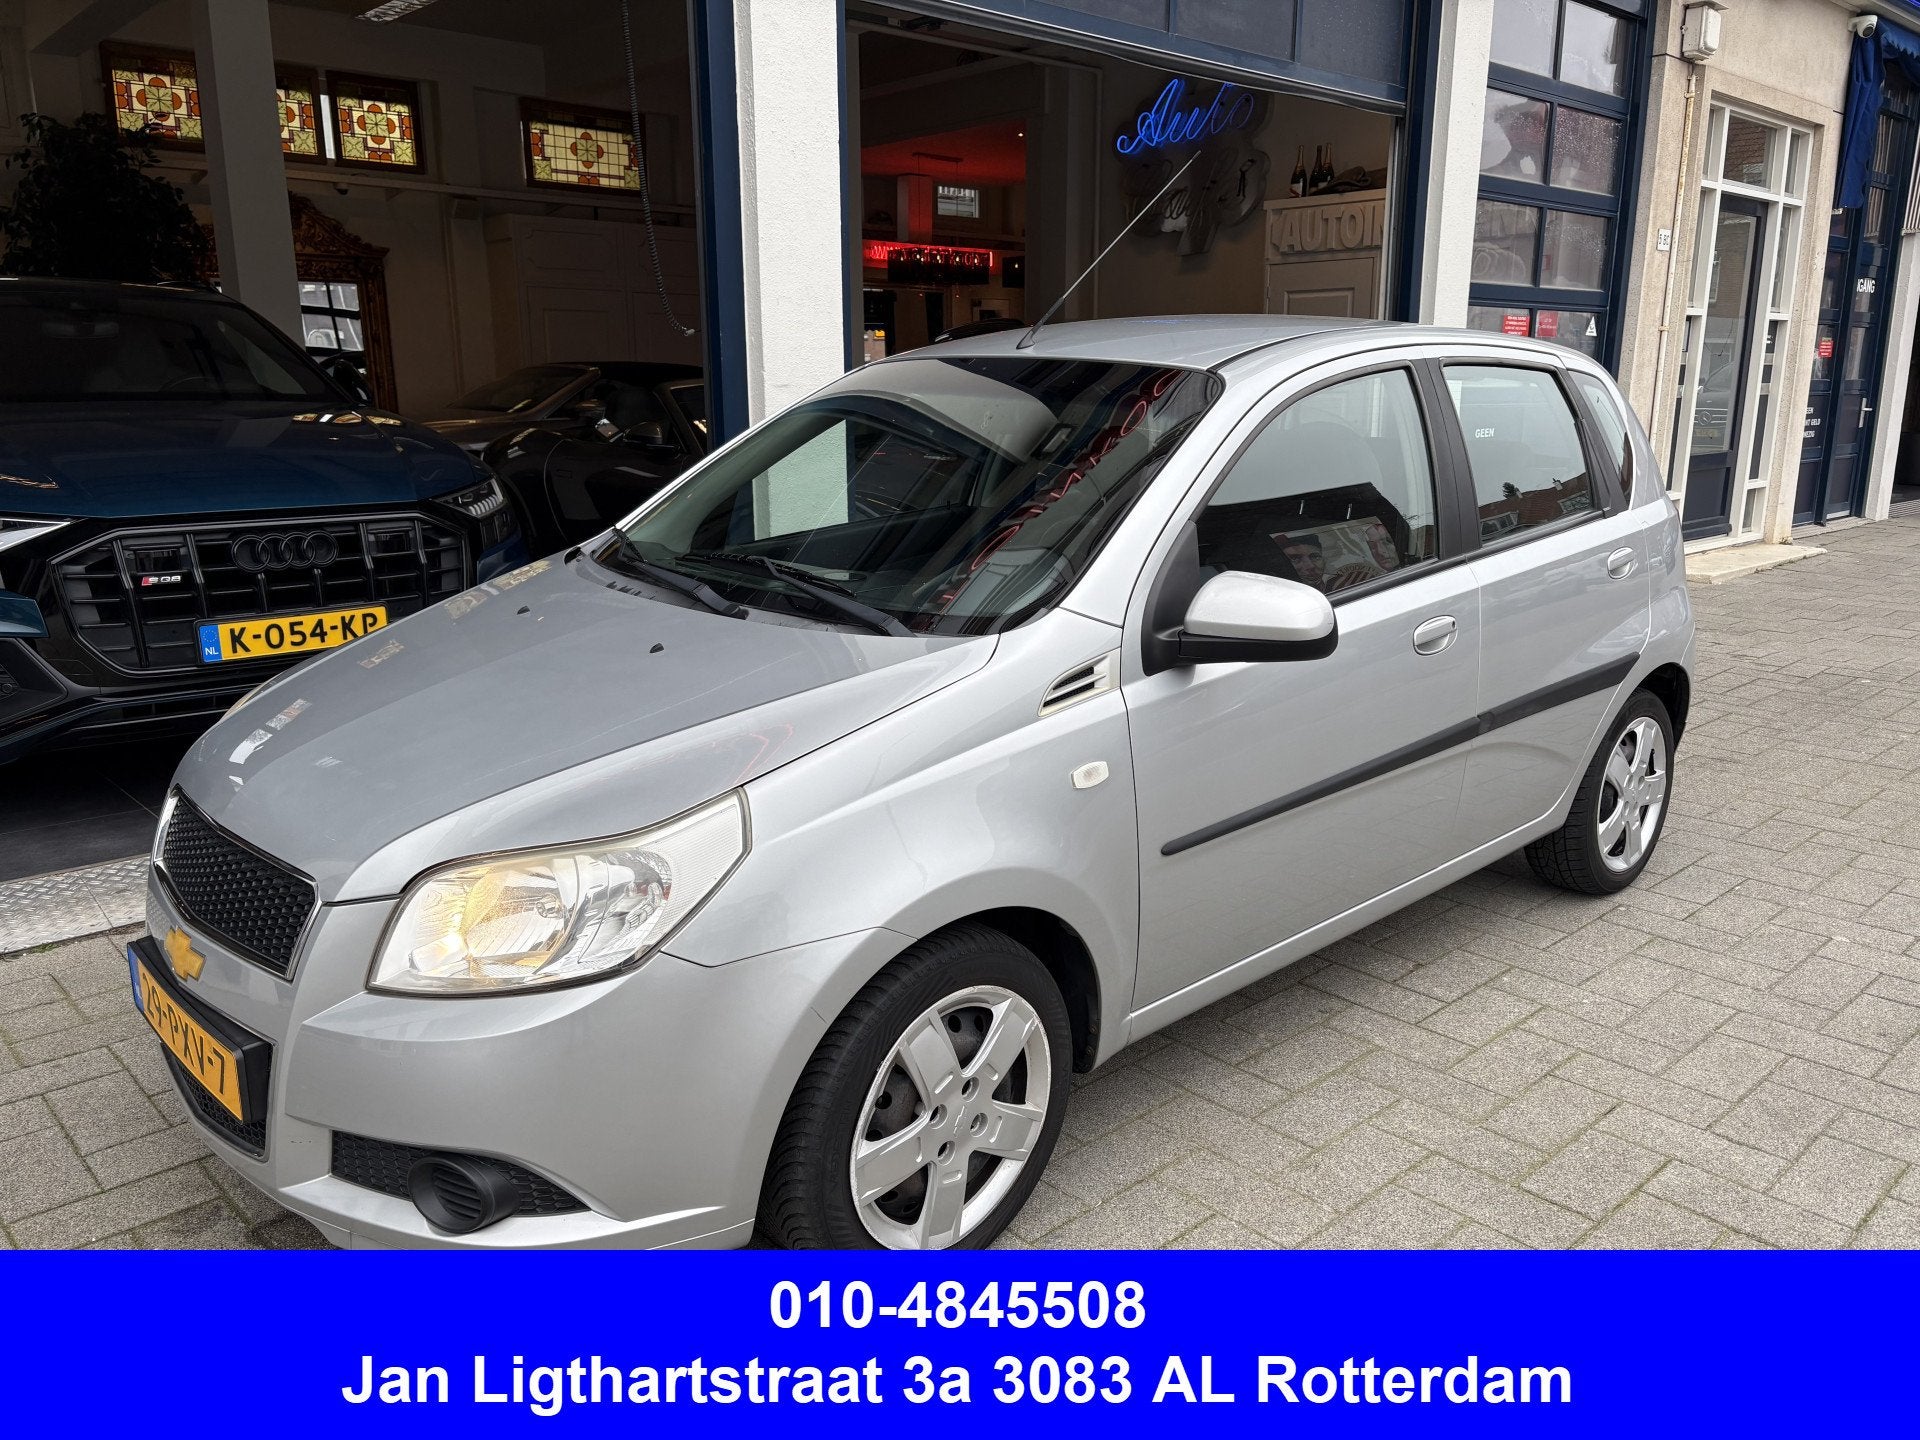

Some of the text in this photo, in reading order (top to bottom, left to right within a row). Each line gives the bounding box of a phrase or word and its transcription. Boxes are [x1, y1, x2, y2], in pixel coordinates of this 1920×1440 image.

[1474, 427, 1495, 439] GEEN
[229, 612, 378, 655] K-054-KP
[204, 646, 219, 656] NL
[143, 972, 225, 1096] 29-PXV-7
